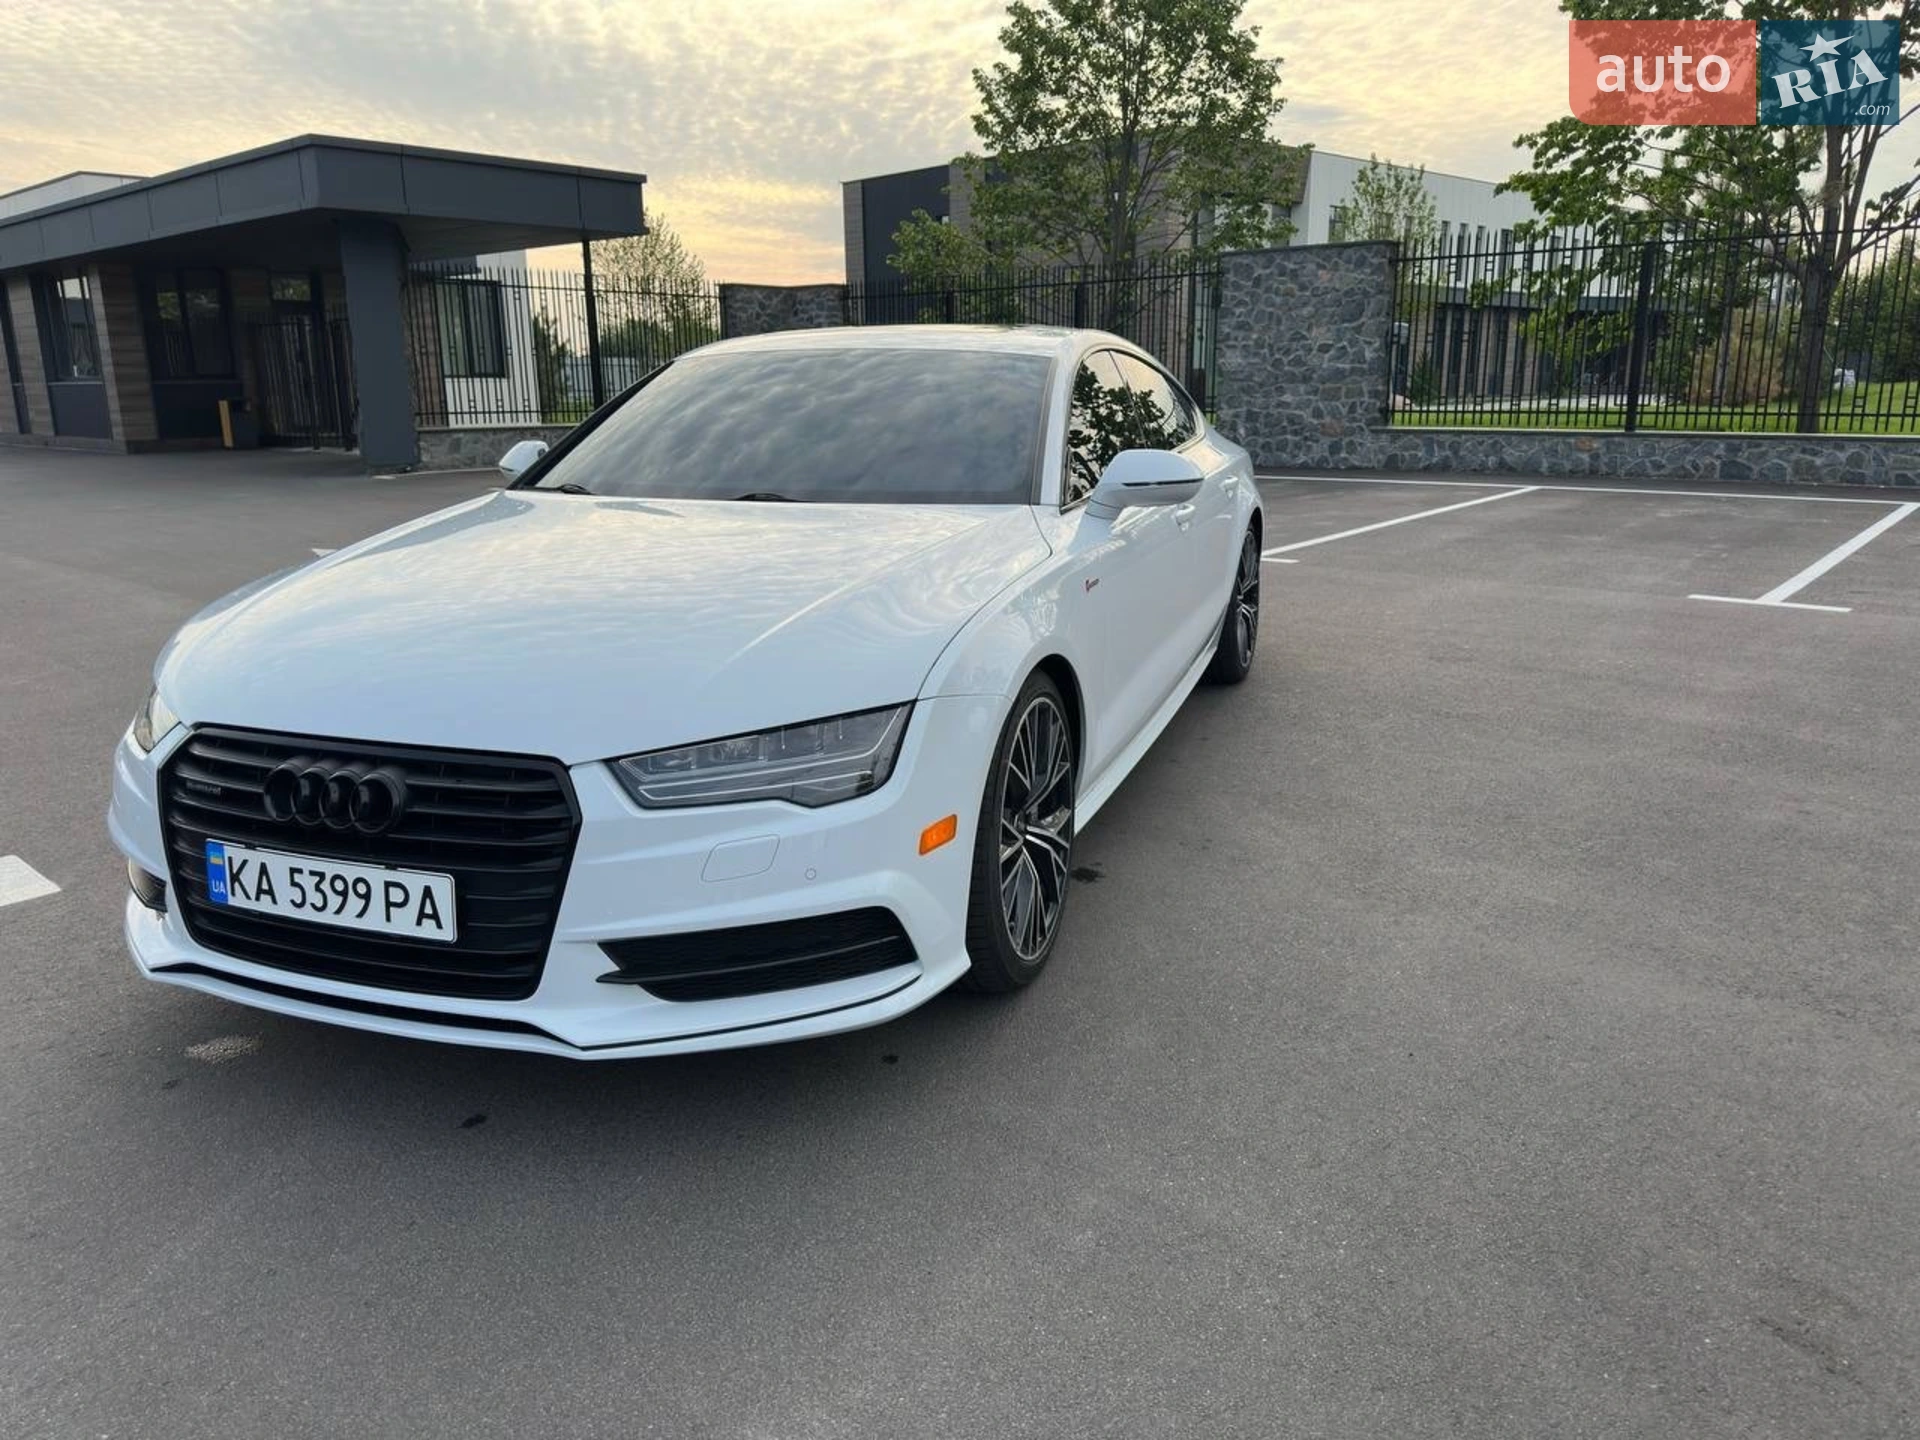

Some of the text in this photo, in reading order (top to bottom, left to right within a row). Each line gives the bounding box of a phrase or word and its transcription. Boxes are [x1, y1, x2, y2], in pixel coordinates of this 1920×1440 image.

[212, 879, 226, 895] UA
[227, 855, 444, 930] KA 5399 PA
